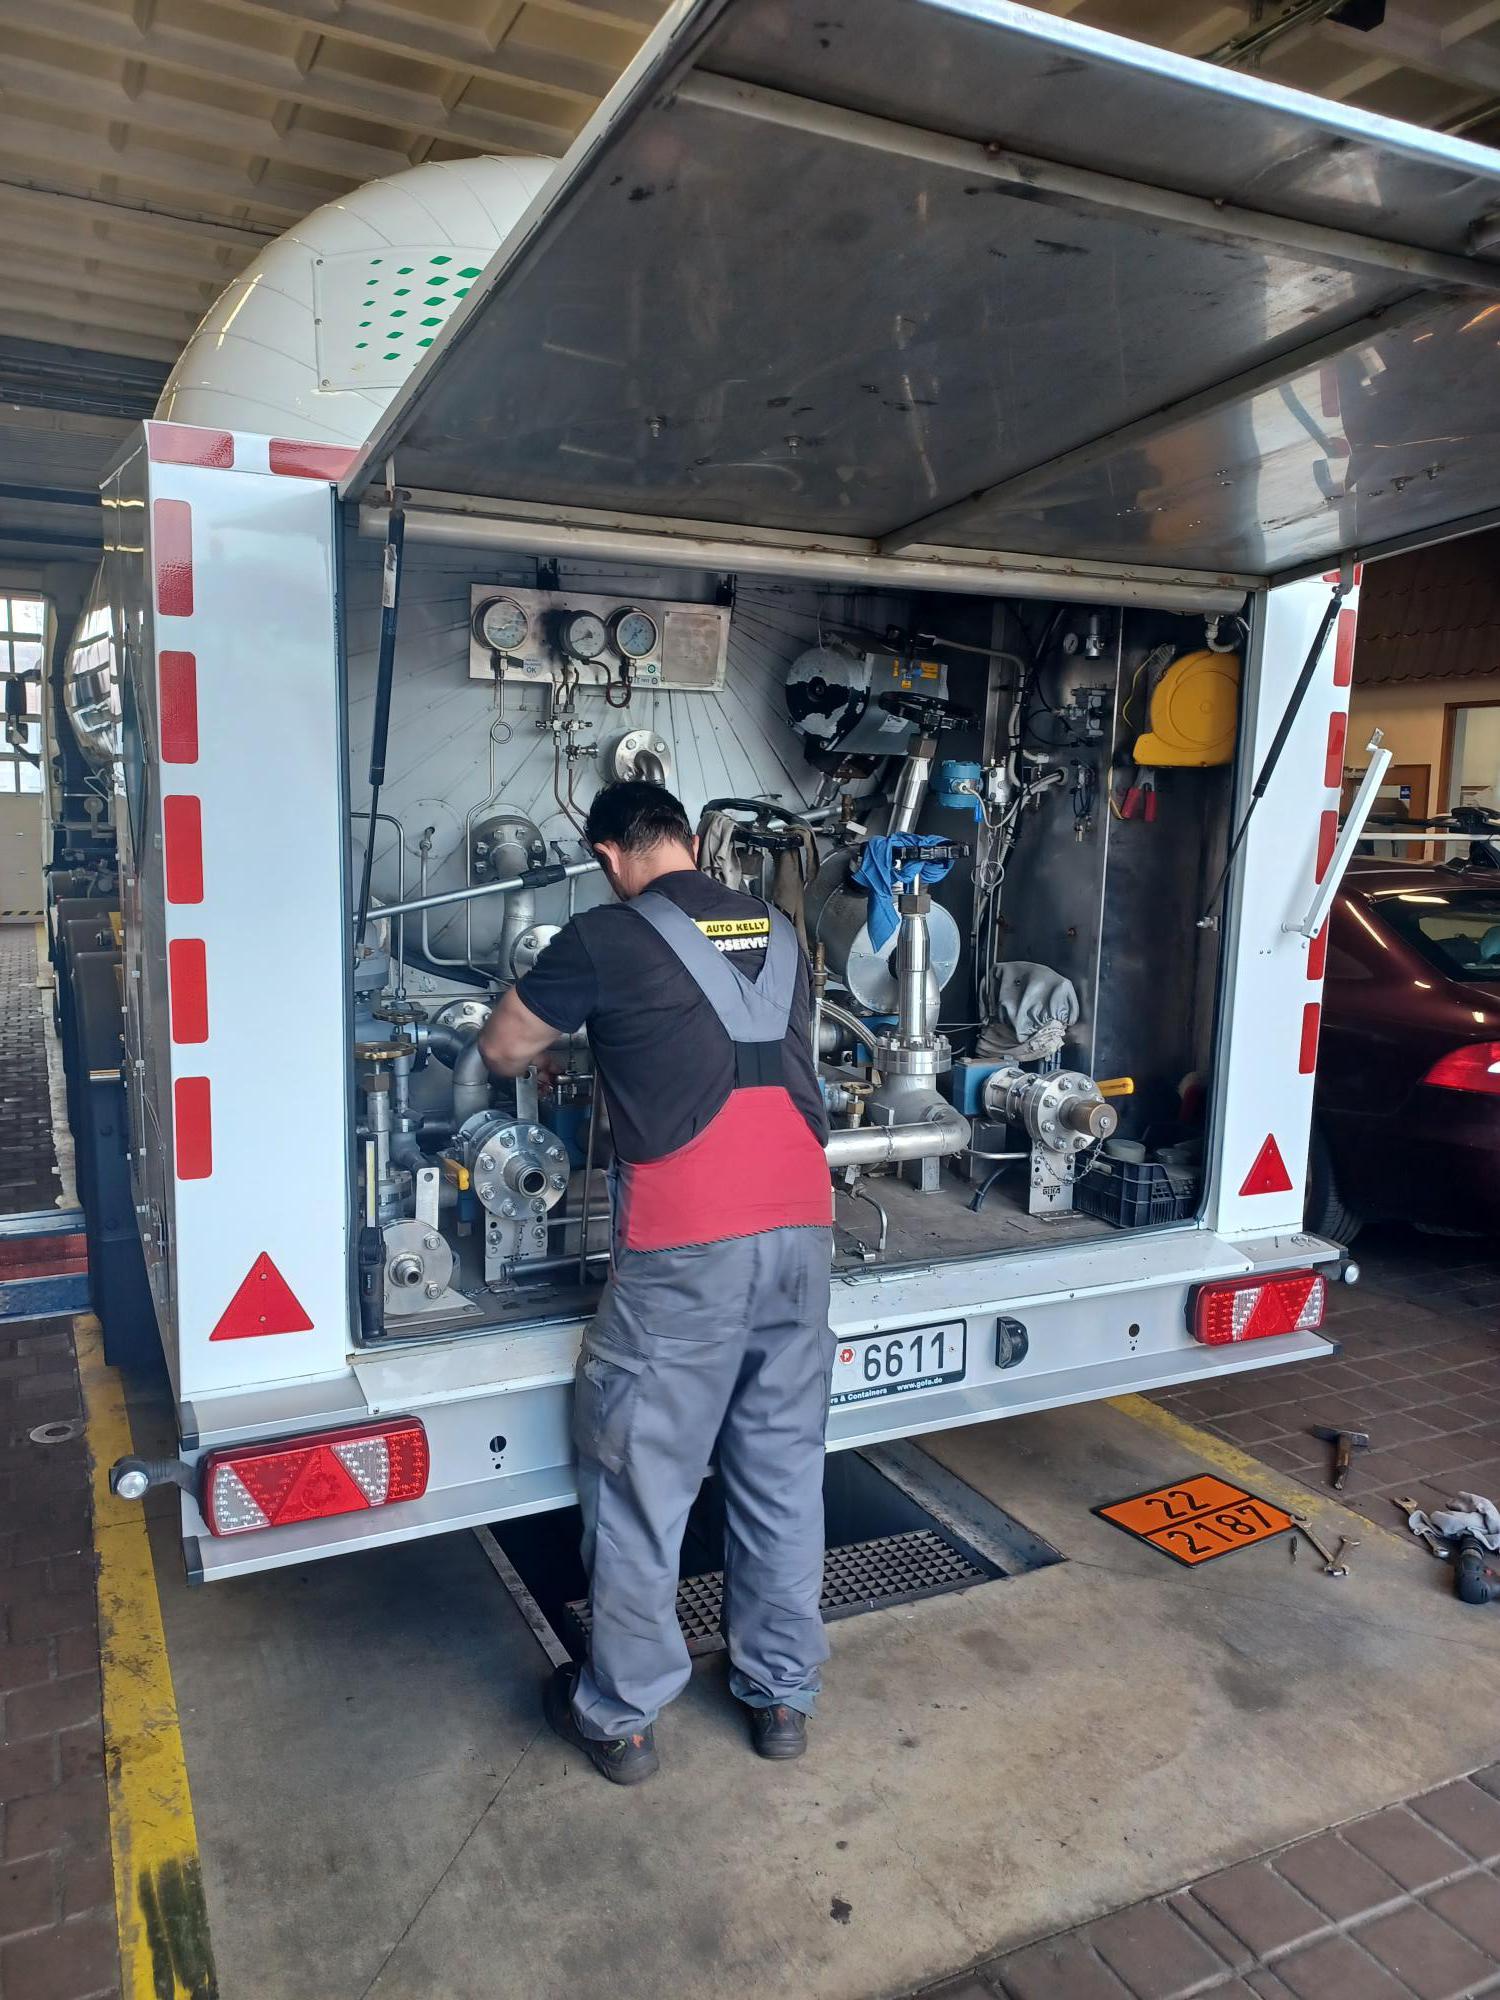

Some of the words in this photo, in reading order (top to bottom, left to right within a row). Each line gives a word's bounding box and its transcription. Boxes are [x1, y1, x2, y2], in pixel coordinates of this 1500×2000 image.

[706, 924, 733, 933] AUTO
[735, 921, 765, 931] KELLY
[712, 936, 768, 951] OSERVIS
[863, 1331, 945, 1382] 6611
[847, 1388, 888, 1401] Containers
[1145, 1490, 1211, 1520] 22
[1167, 1504, 1272, 1555] 2187
